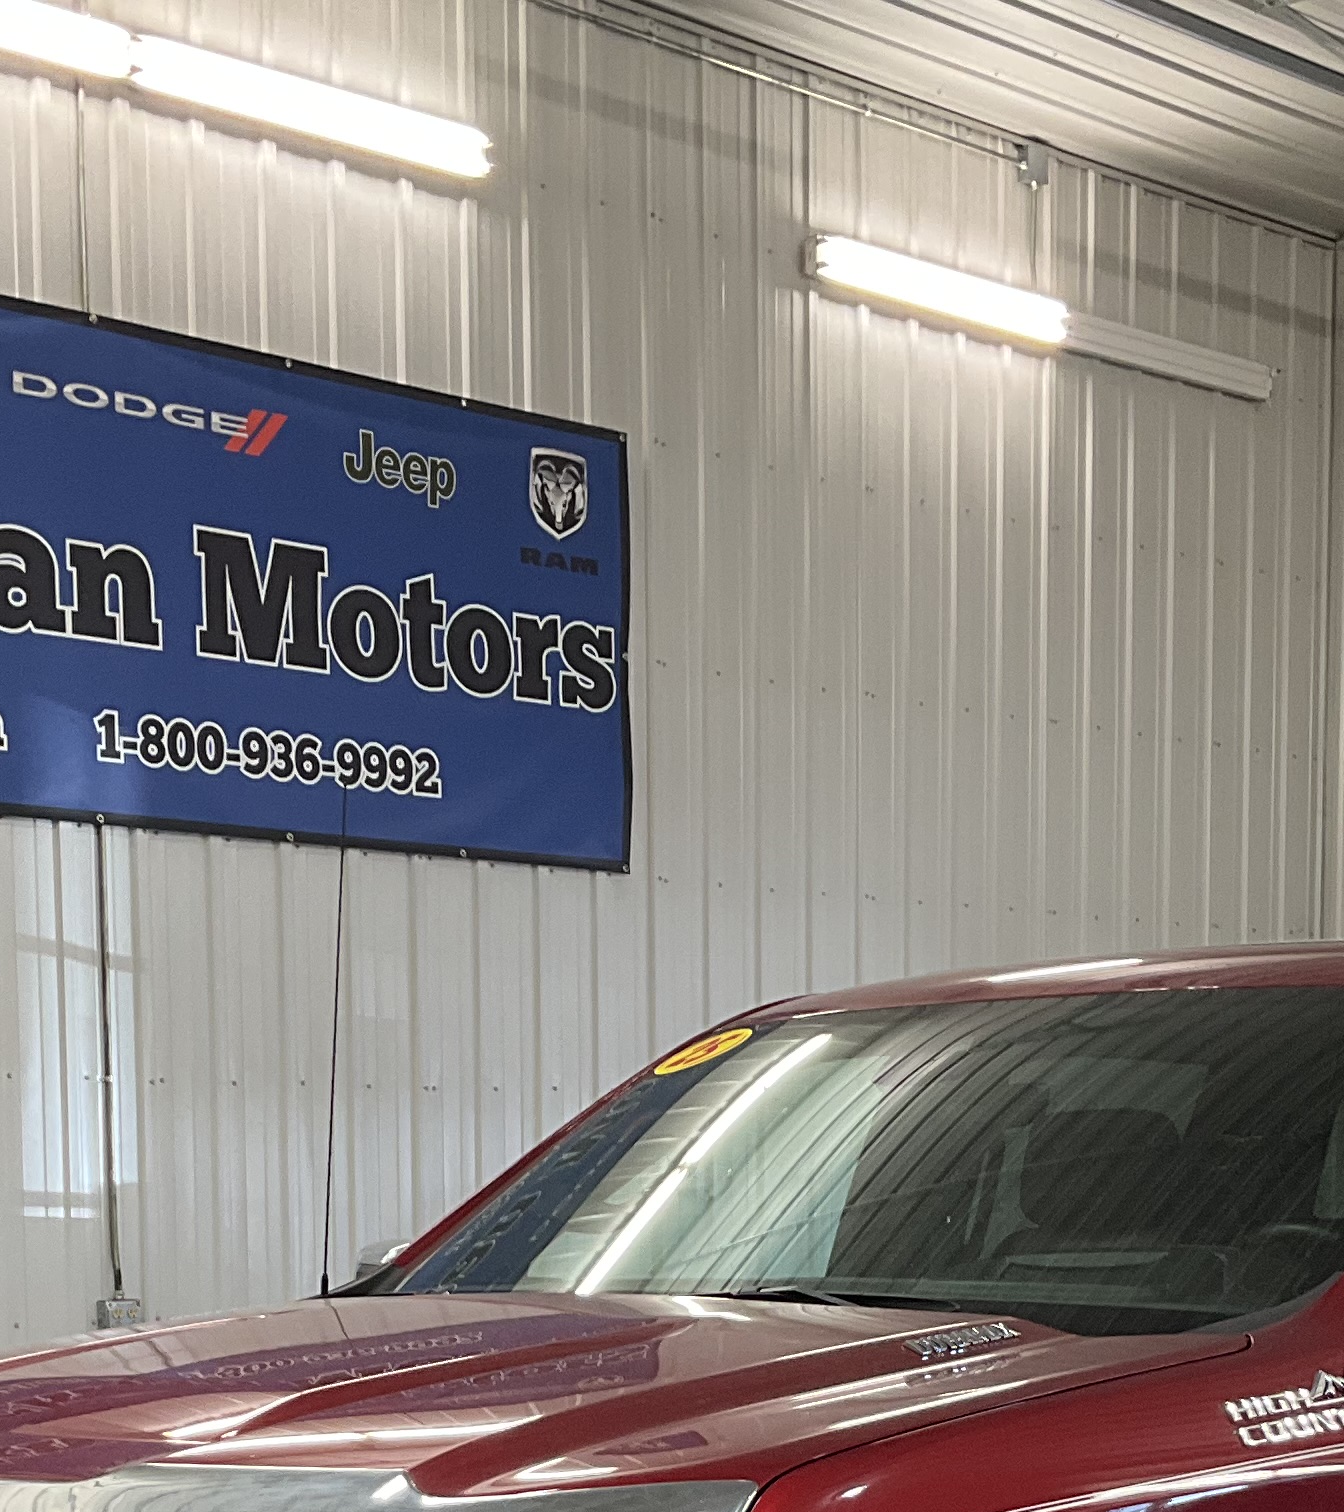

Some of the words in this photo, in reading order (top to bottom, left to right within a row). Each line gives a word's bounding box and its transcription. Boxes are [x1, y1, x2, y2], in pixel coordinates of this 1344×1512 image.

[12, 370, 250, 438] DODGE
[344, 429, 456, 507] Jeep
[520, 547, 599, 576] RAM
[193, 524, 616, 713] Motors
[93, 709, 442, 798] 1-800-936-9992
[1224, 1387, 1314, 1423] HIGH
